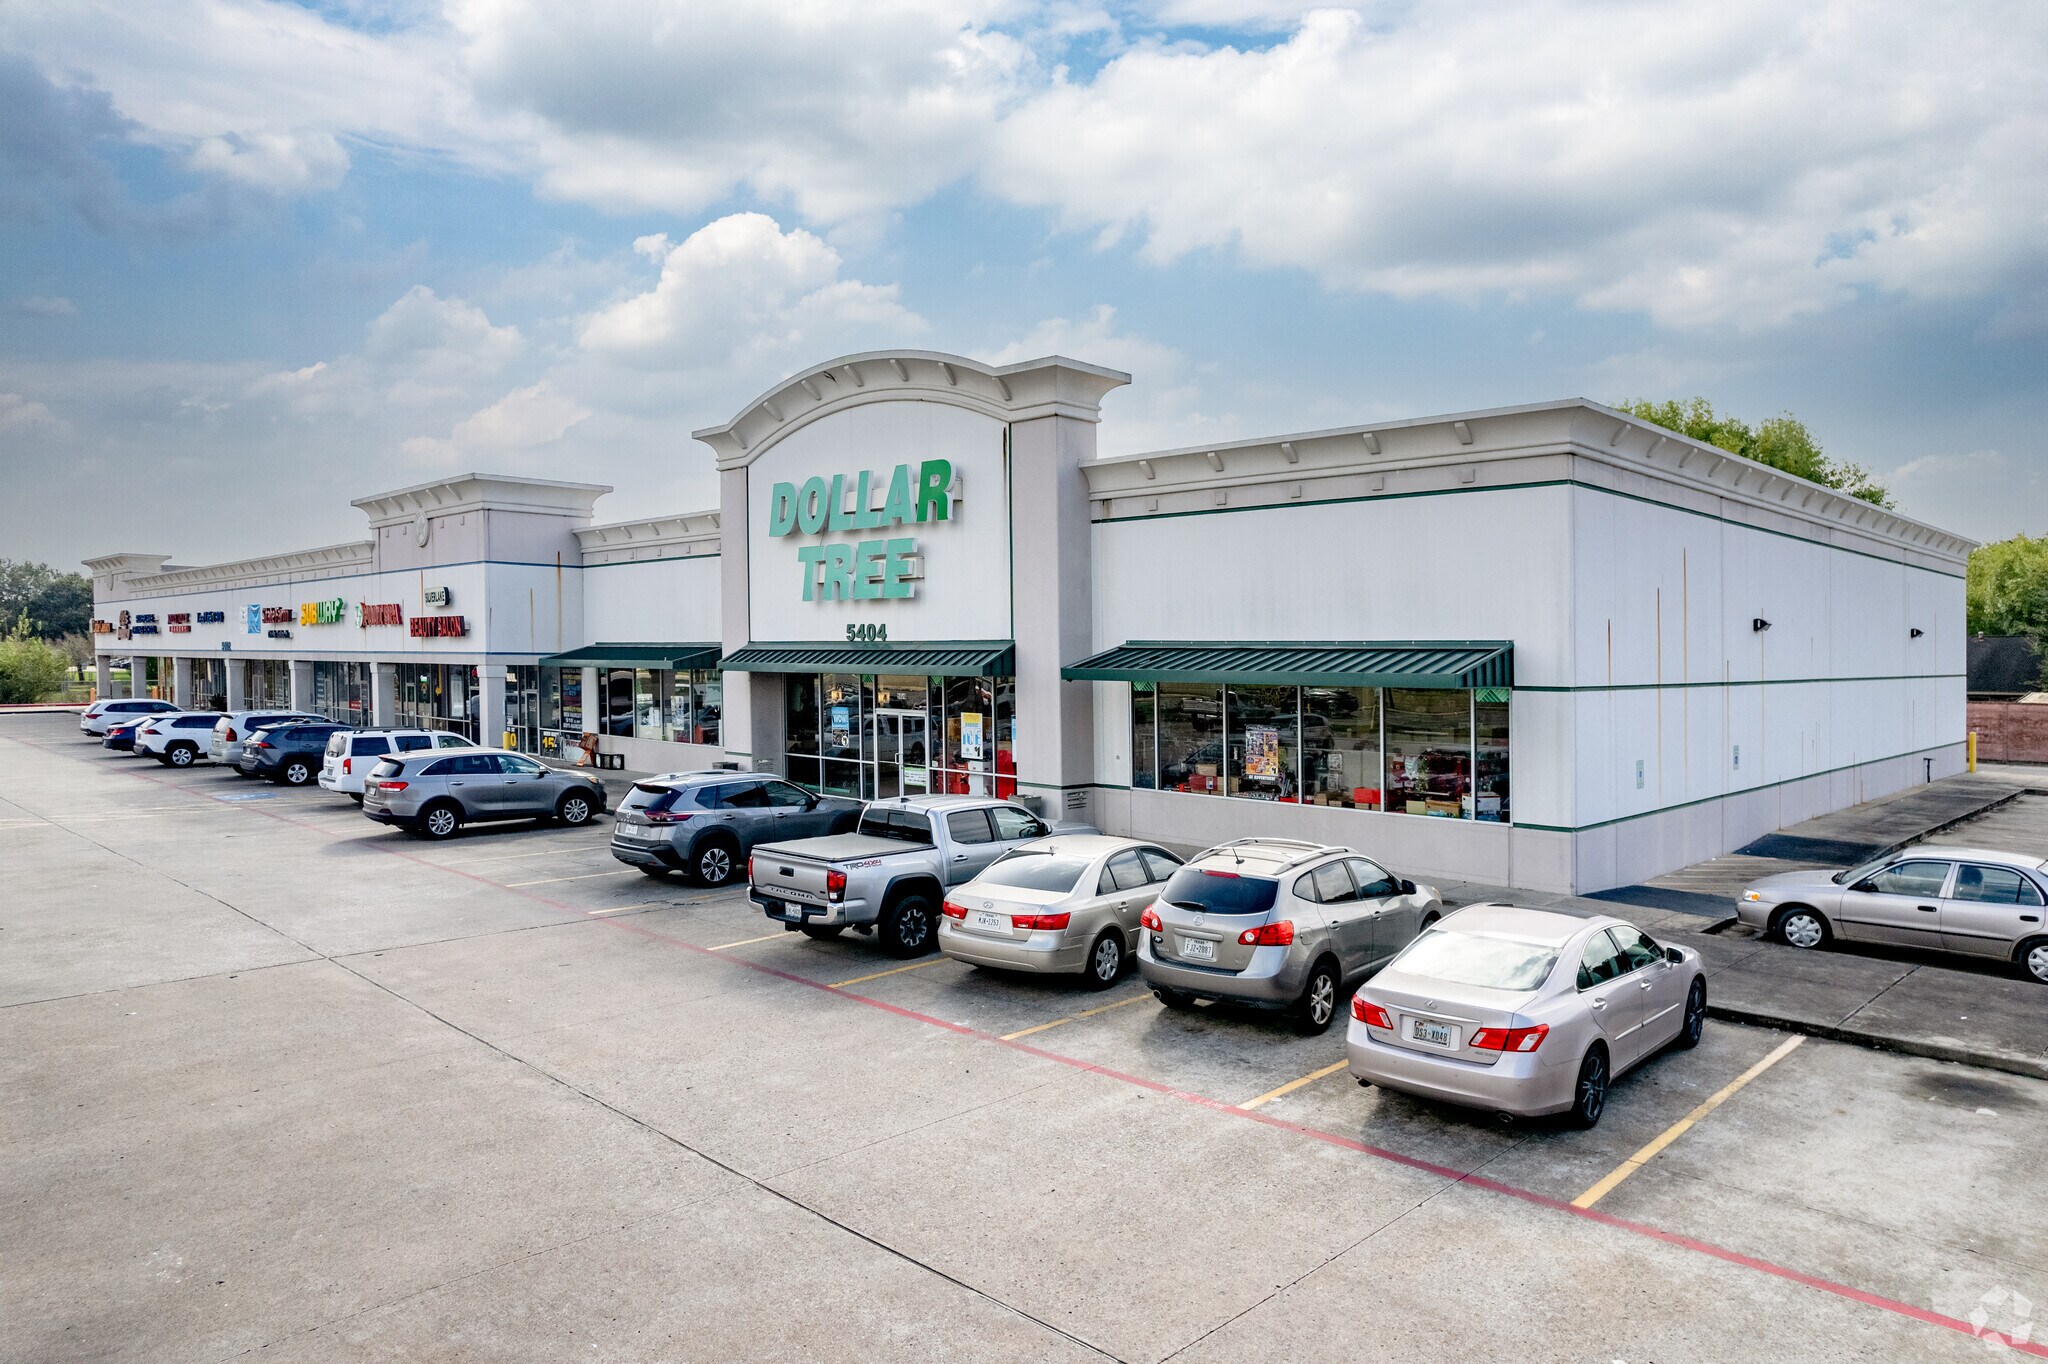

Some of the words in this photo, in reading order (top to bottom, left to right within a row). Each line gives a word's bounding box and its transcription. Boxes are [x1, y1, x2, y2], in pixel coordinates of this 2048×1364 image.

[769, 459, 956, 537] DOLLAR
[798, 538, 918, 601] TREE
[300, 598, 343, 626] SUBWAY
[410, 617, 437, 637] BEAUTY
[438, 616, 464, 637] SALON
[846, 623, 887, 641] 5404
[769, 887, 813, 899] TACOMA
